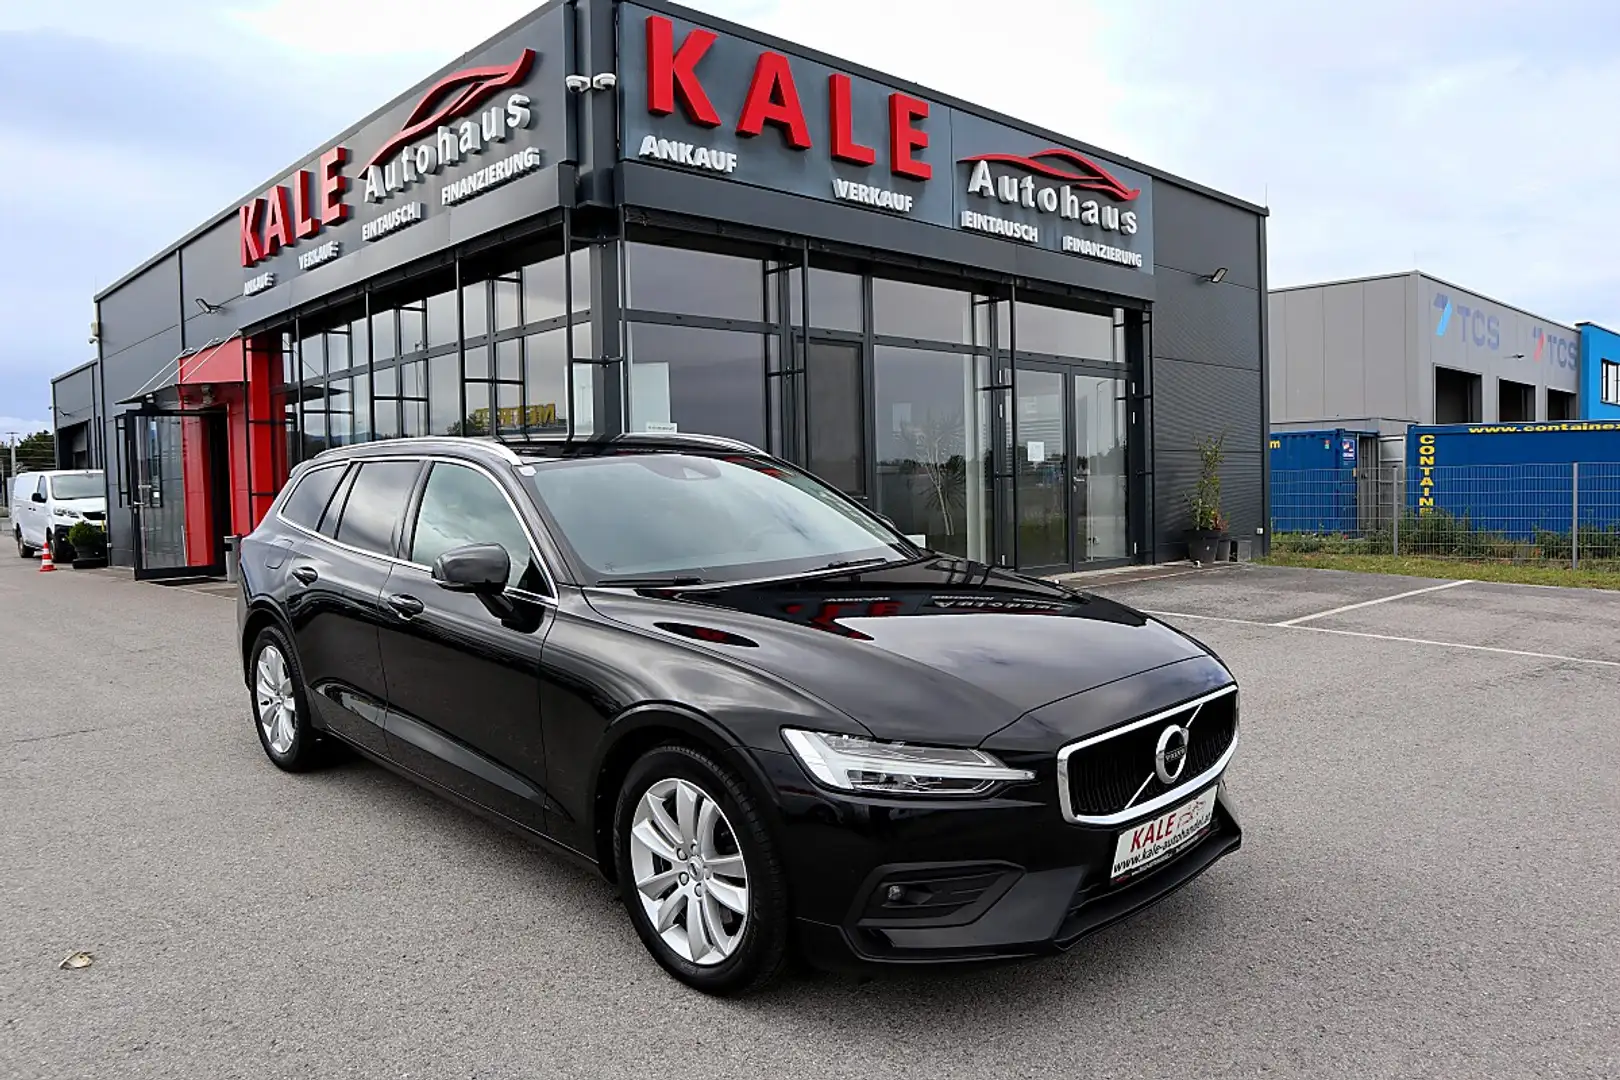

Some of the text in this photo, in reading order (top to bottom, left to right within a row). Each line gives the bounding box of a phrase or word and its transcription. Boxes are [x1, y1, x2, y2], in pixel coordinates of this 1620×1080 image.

[646, 15, 932, 180] KALE
[364, 94, 531, 203] Autohaus
[638, 135, 912, 213] ANKAUF VERKAUF
[240, 146, 346, 267] KALE
[362, 147, 540, 241] EINTAUSCH FINANZIERUNG
[967, 159, 1137, 235] Autohaus
[961, 210, 1142, 268] EINTAUSCH FINANZIERUNG
[1457, 305, 1500, 351] TCS
[1547, 334, 1578, 371] TCS
[1130, 812, 1177, 853] KALE
